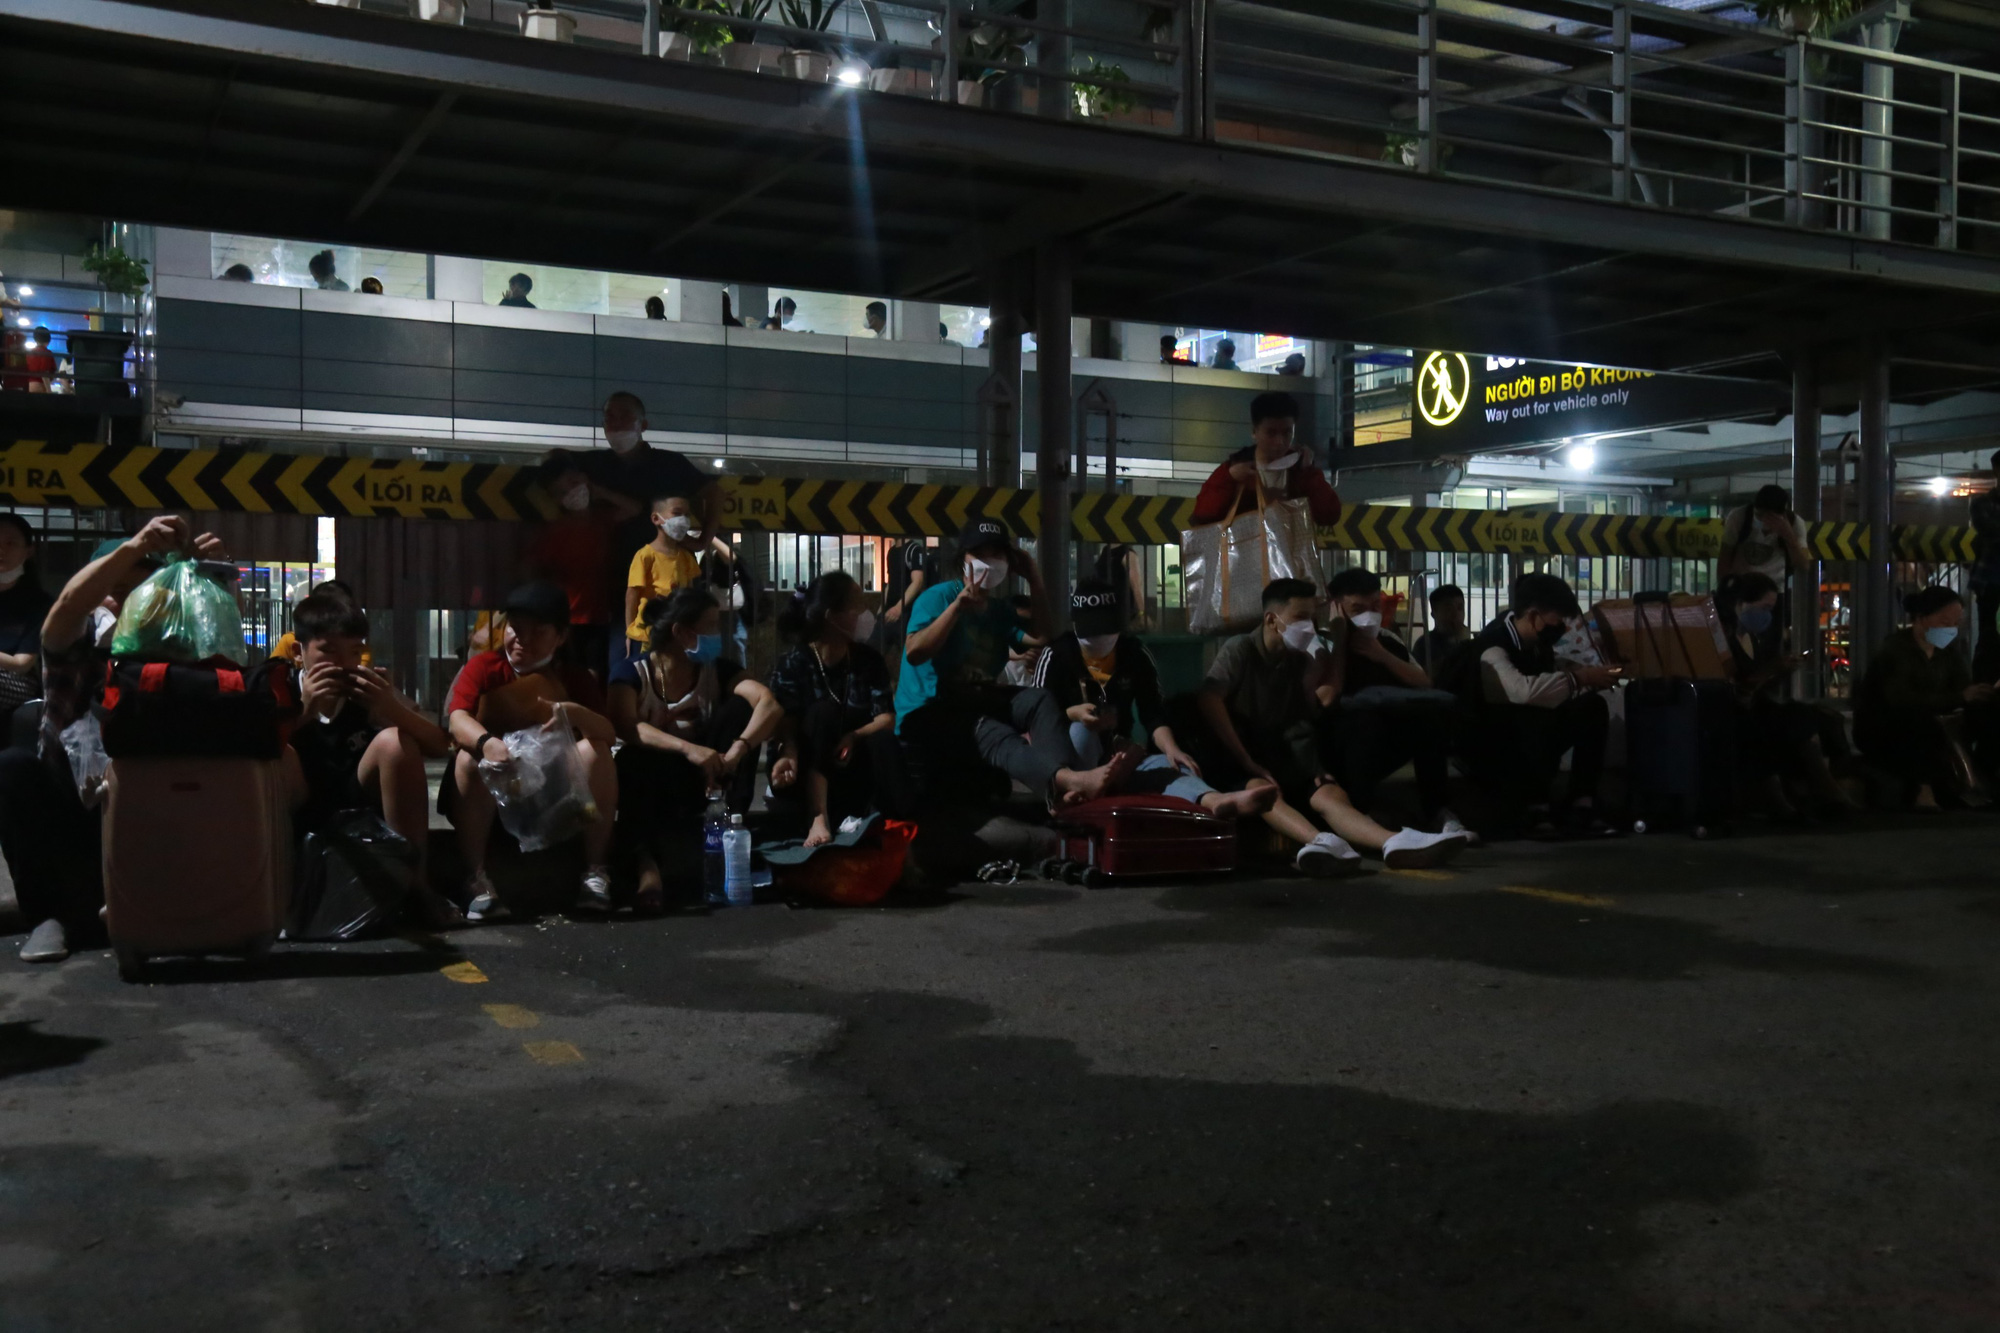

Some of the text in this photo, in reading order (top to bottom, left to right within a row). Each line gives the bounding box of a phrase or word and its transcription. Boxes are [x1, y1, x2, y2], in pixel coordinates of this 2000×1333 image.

[1485, 375, 1535, 404] NGƯỜI
[1539, 374, 1556, 395] ĐI
[1561, 366, 1586, 393] BỘ
[1485, 388, 1629, 424] Way out for vehicle only
[27, 468, 66, 490] RA
[373, 475, 453, 504] LỐI RA
[722, 489, 779, 515] ỐI RA
[1495, 522, 1539, 542] LỐI RA
[1703, 534, 1718, 547] RA
[1072, 592, 1117, 608] SPORT
